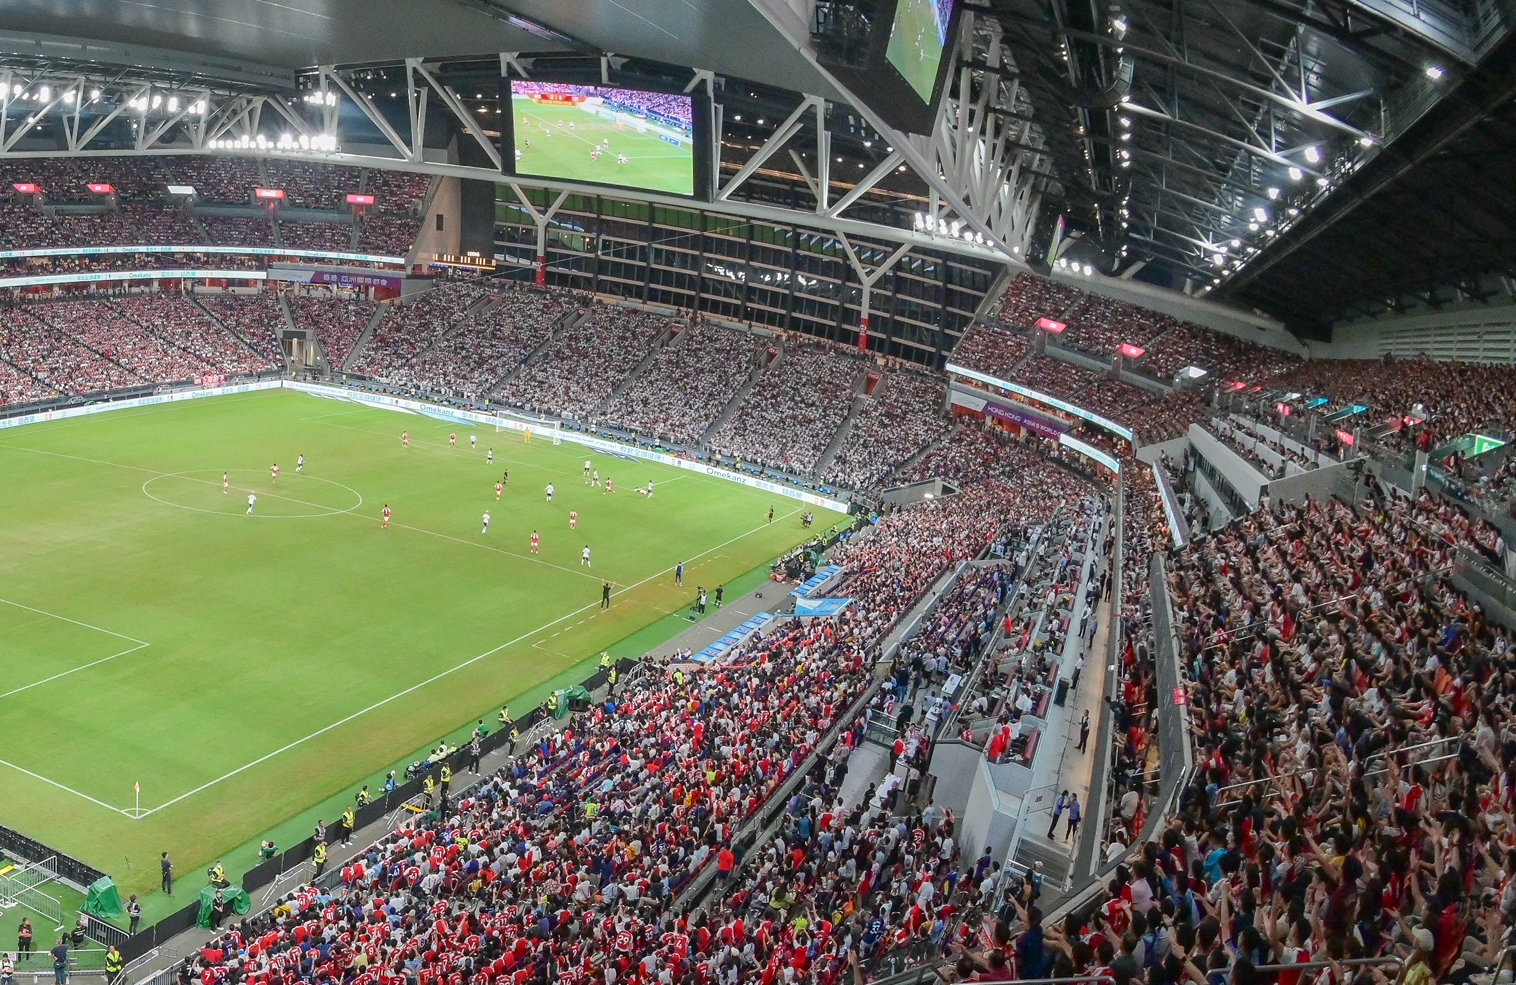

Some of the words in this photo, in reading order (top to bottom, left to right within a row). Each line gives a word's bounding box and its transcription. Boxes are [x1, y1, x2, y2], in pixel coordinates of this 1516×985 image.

[419, 403, 455, 416] Omekanz
[987, 405, 1005, 417] HONG
[1004, 411, 1021, 423] KONG
[706, 467, 747, 484] Omekanz
[617, 935, 630, 945] 29
[205, 972, 211, 982] 7
